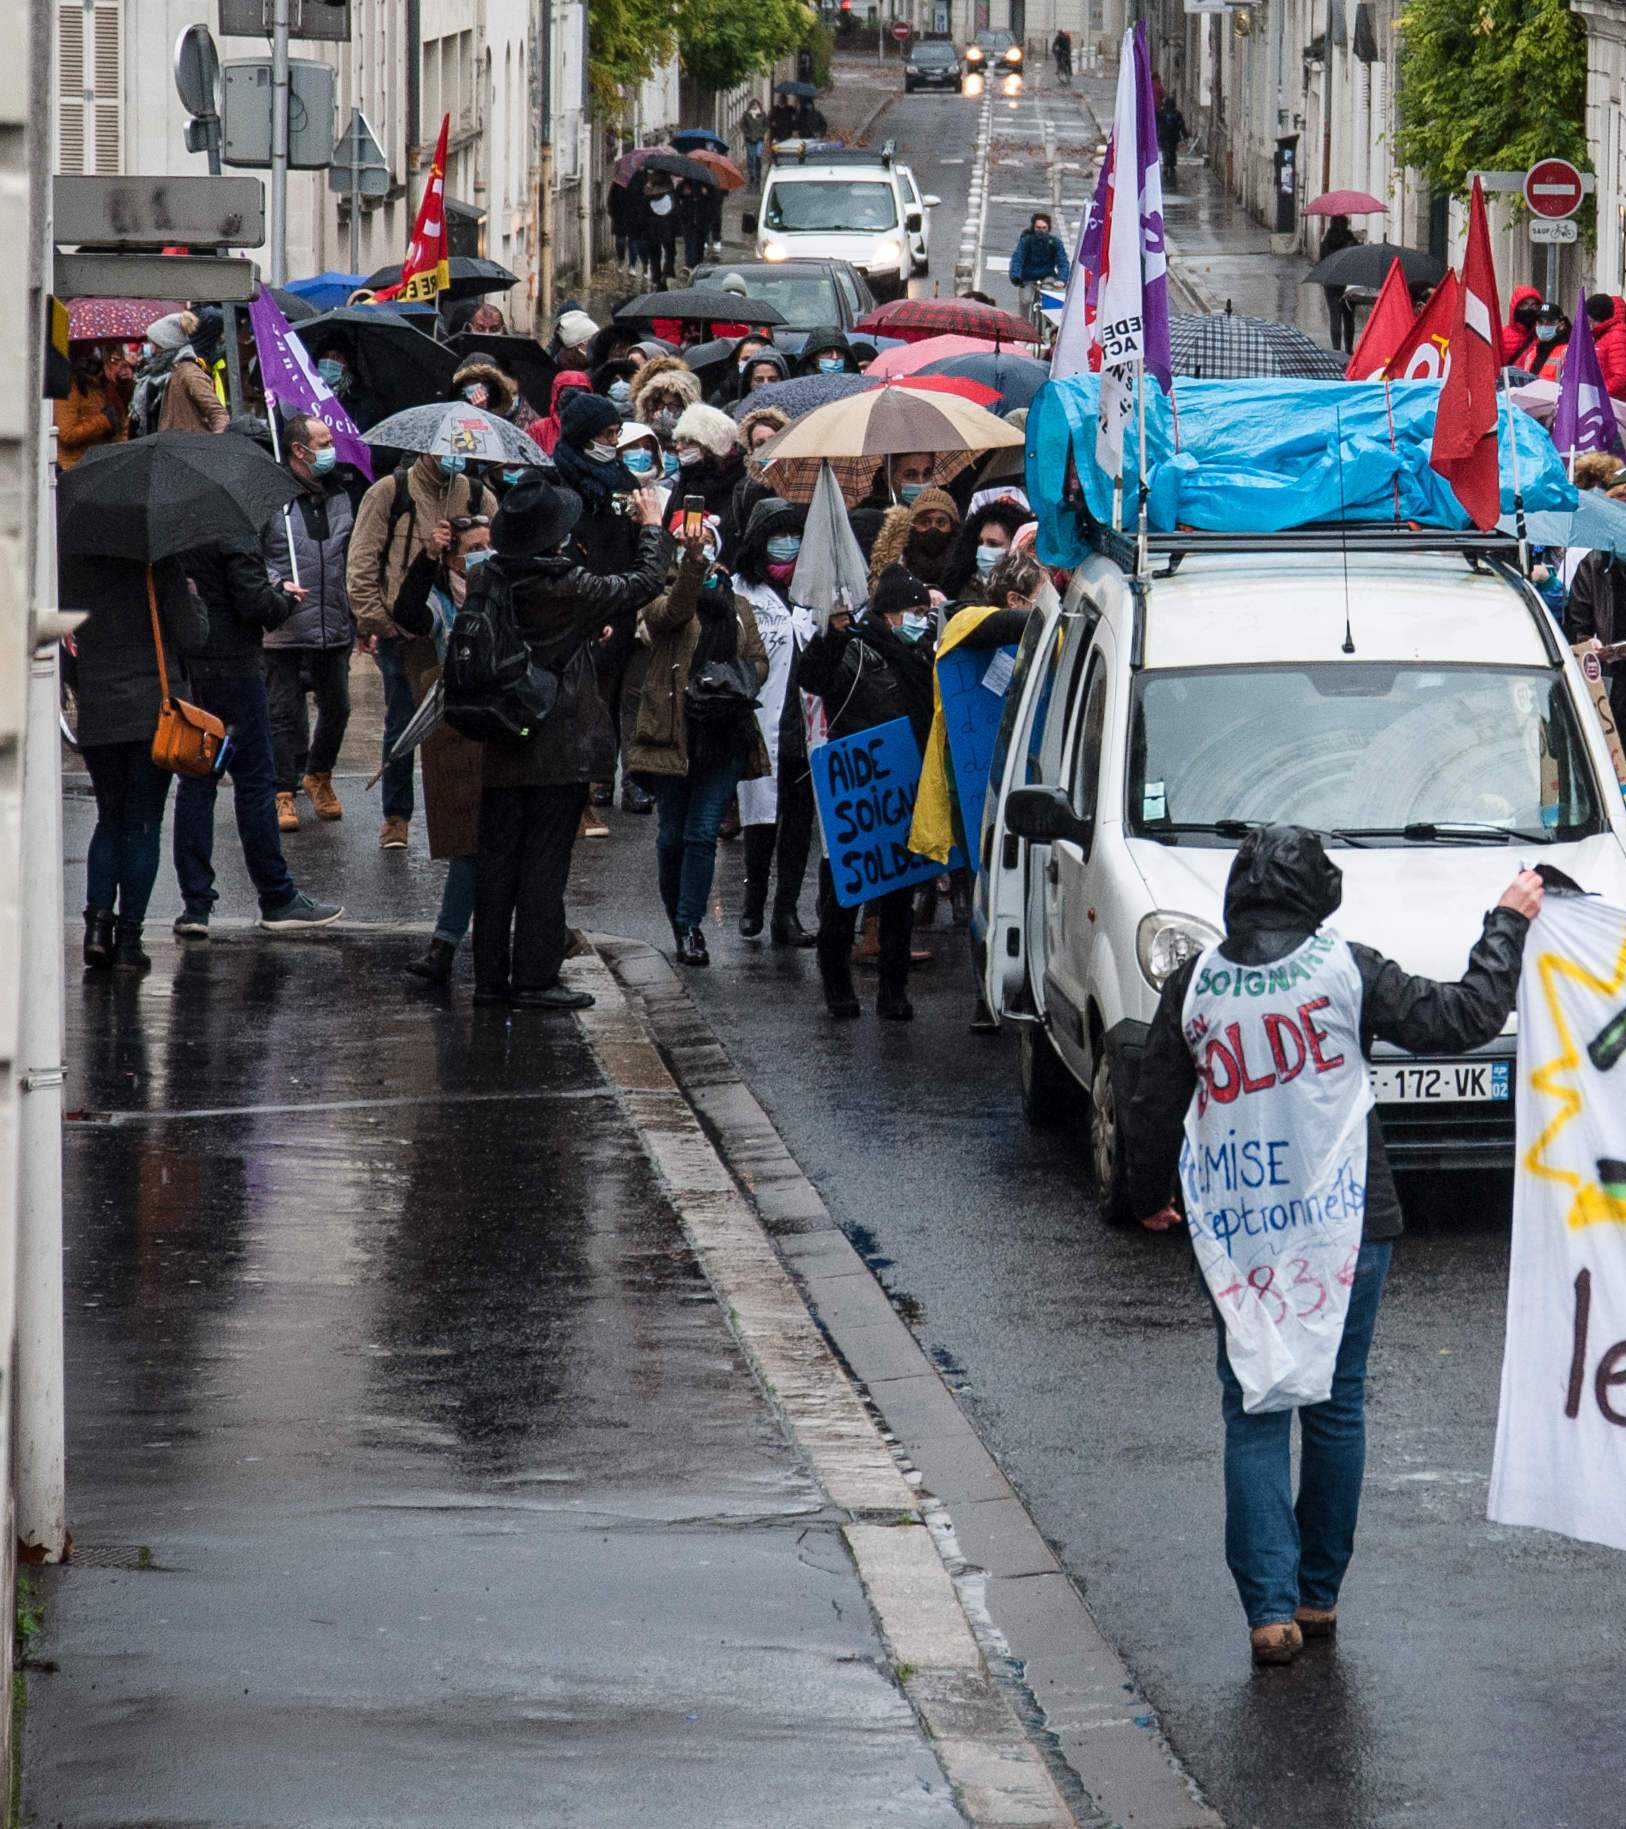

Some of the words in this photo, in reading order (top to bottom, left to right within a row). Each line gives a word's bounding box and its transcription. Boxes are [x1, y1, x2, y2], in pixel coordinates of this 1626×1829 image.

[1532, 227, 1550, 235] SAUF
[827, 738, 890, 798] AIDE
[1492, 1083, 1508, 1097] 02
